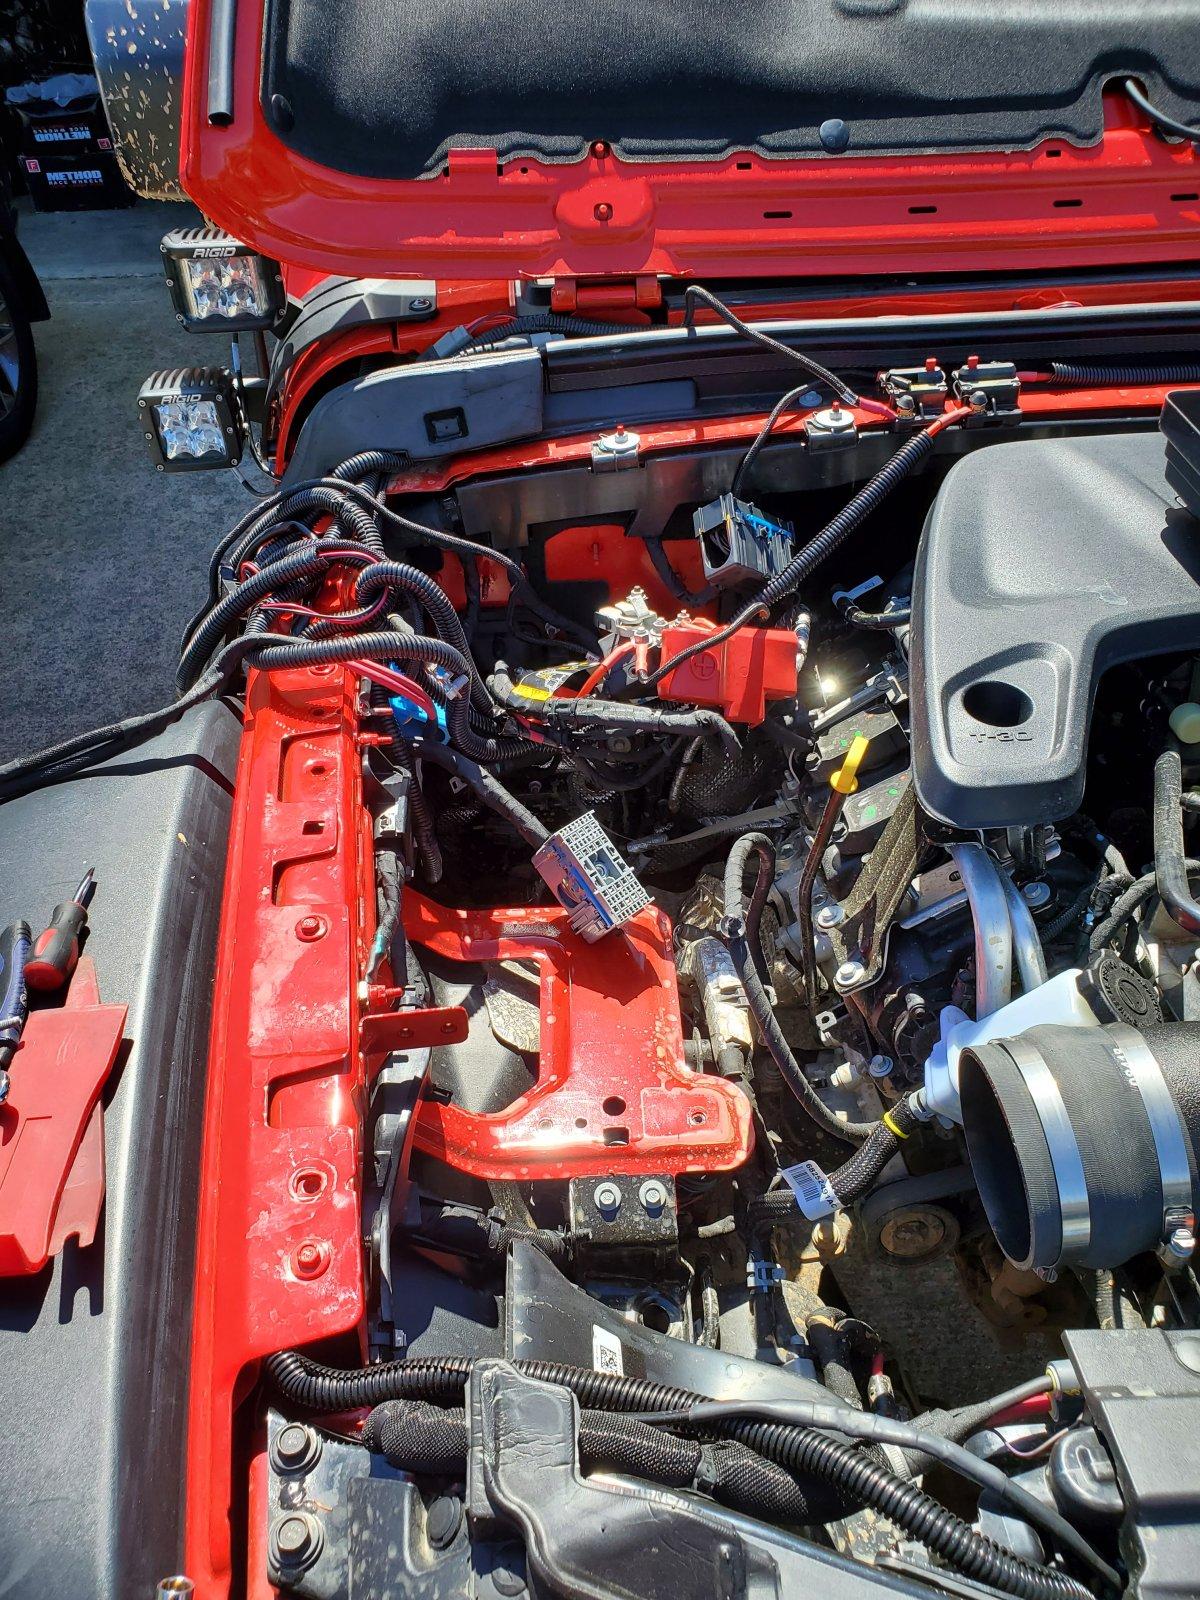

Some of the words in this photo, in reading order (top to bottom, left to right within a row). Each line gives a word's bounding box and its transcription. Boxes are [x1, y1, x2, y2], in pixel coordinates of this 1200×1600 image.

[34, 130, 91, 142] METHOD
[46, 170, 102, 181] METHOD
[193, 247, 236, 258] RIGID
[161, 394, 202, 404] RIGID
